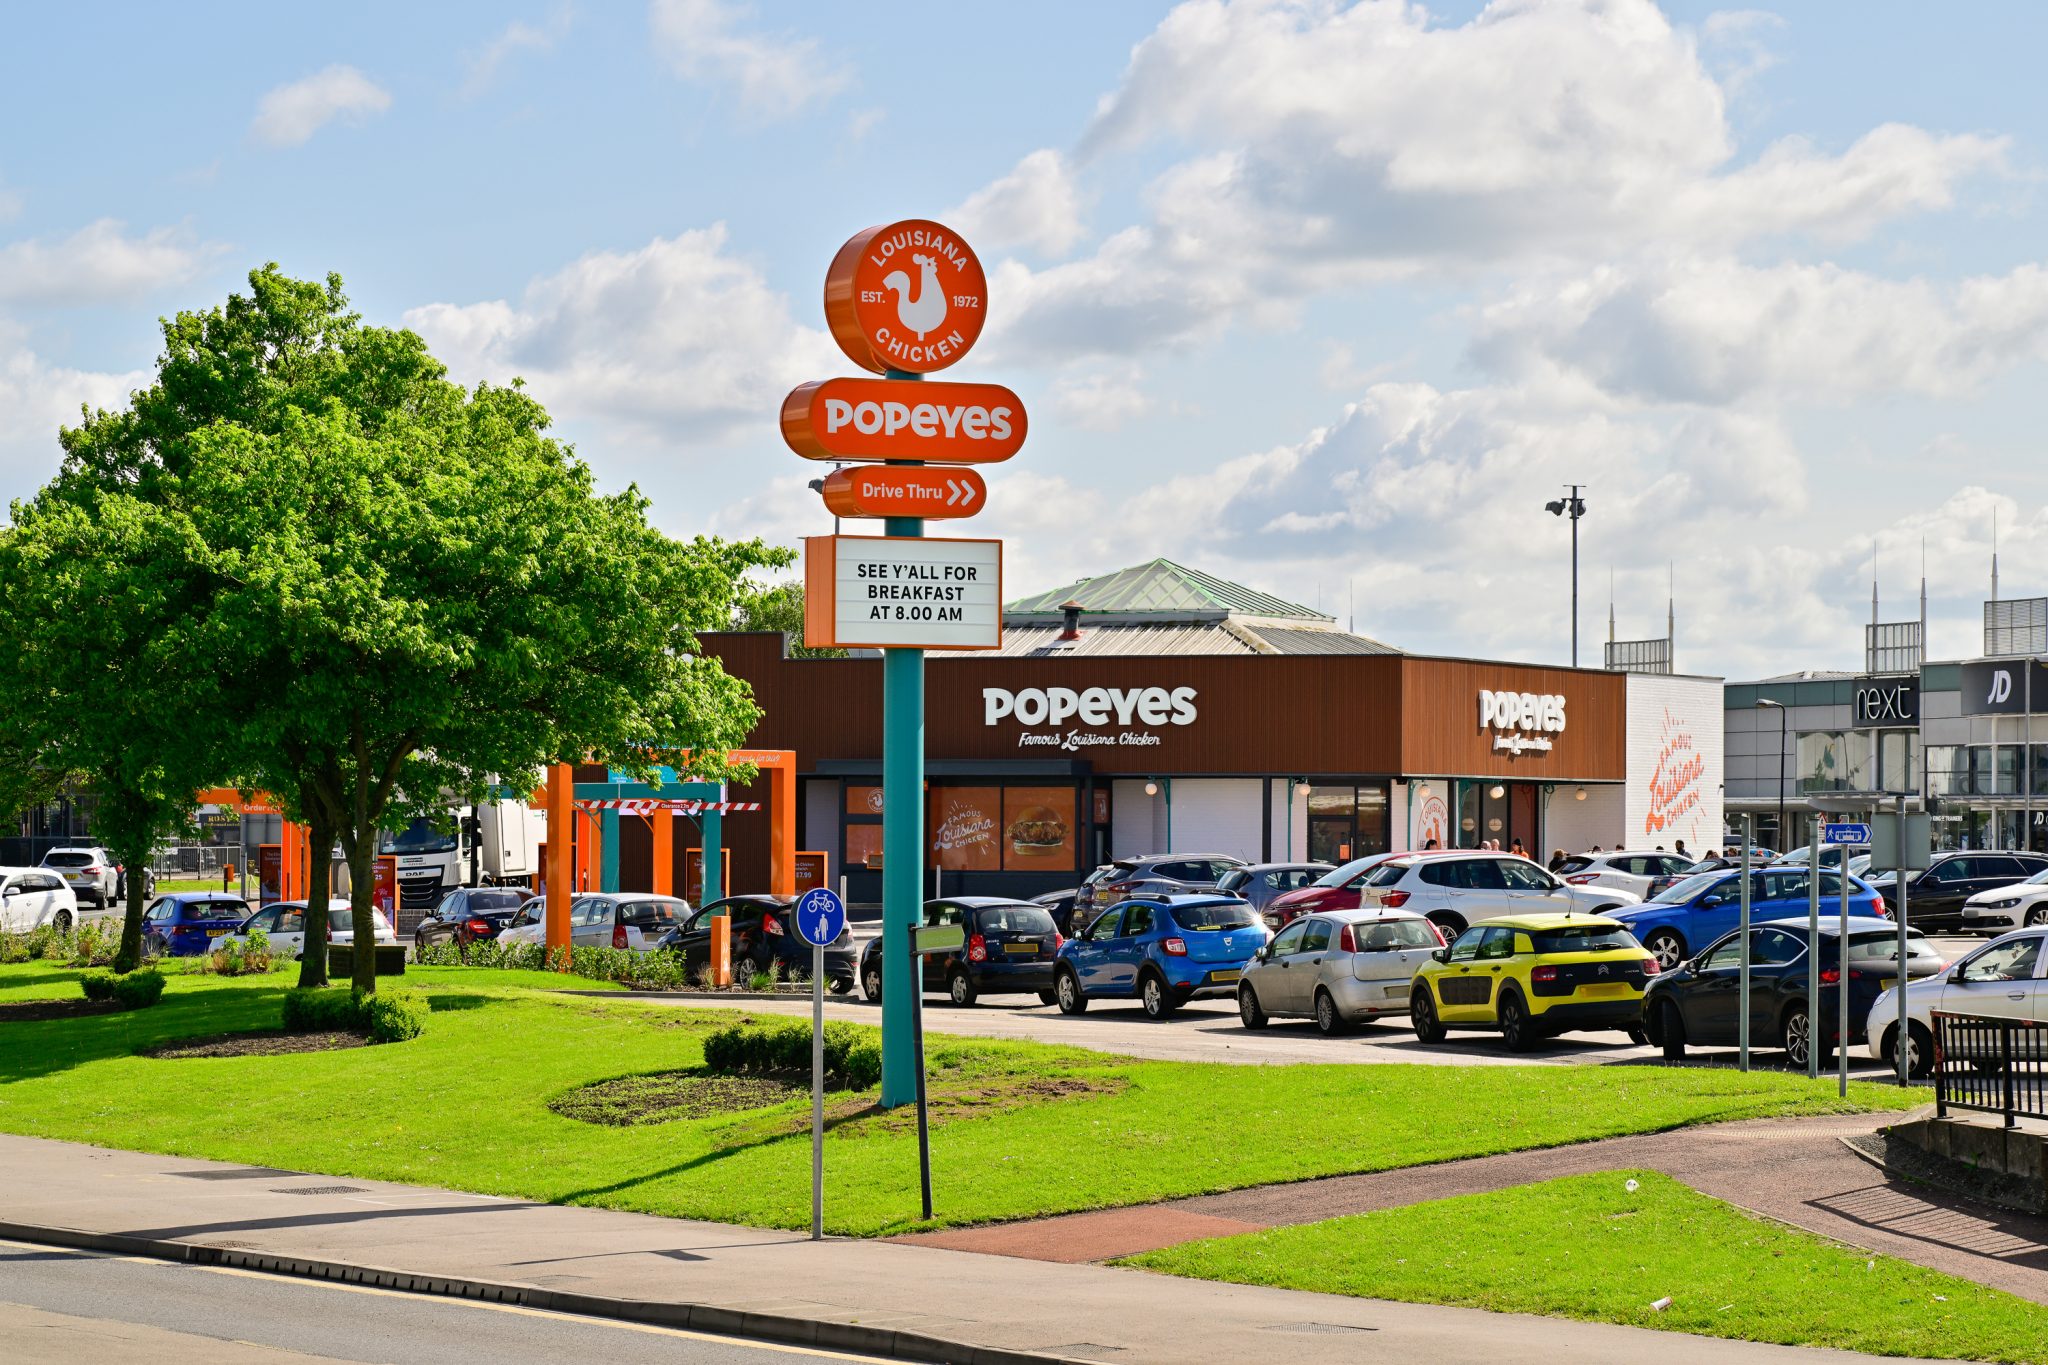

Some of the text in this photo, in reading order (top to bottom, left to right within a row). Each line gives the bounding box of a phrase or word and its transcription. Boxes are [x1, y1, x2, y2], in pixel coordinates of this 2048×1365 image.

[870, 230, 969, 273] LOUISIANA
[861, 290, 886, 304] EST.
[952, 295, 979, 308] 1972
[875, 327, 965, 363] CHICKEN
[862, 482, 943, 499] Drive Thru
[857, 563, 978, 581] SEE Y'ALL FOR
[867, 584, 965, 601] BREAKFAST
[869, 605, 963, 621] AT 8.00 AM
[1987, 670, 2012, 704] JD
[1856, 684, 1912, 720] next
[1018, 729, 1161, 751] Famous Louisiana Chicken
[1660, 733, 1692, 772] FAMOUS
[243, 804, 266, 812] Order
[1666, 787, 1700, 828] CHICKEN
[947, 810, 981, 825] FAMOUS
[2034, 811, 2045, 825] JD
[934, 818, 995, 850] Louisiana
[955, 832, 989, 848] CHICKEN
